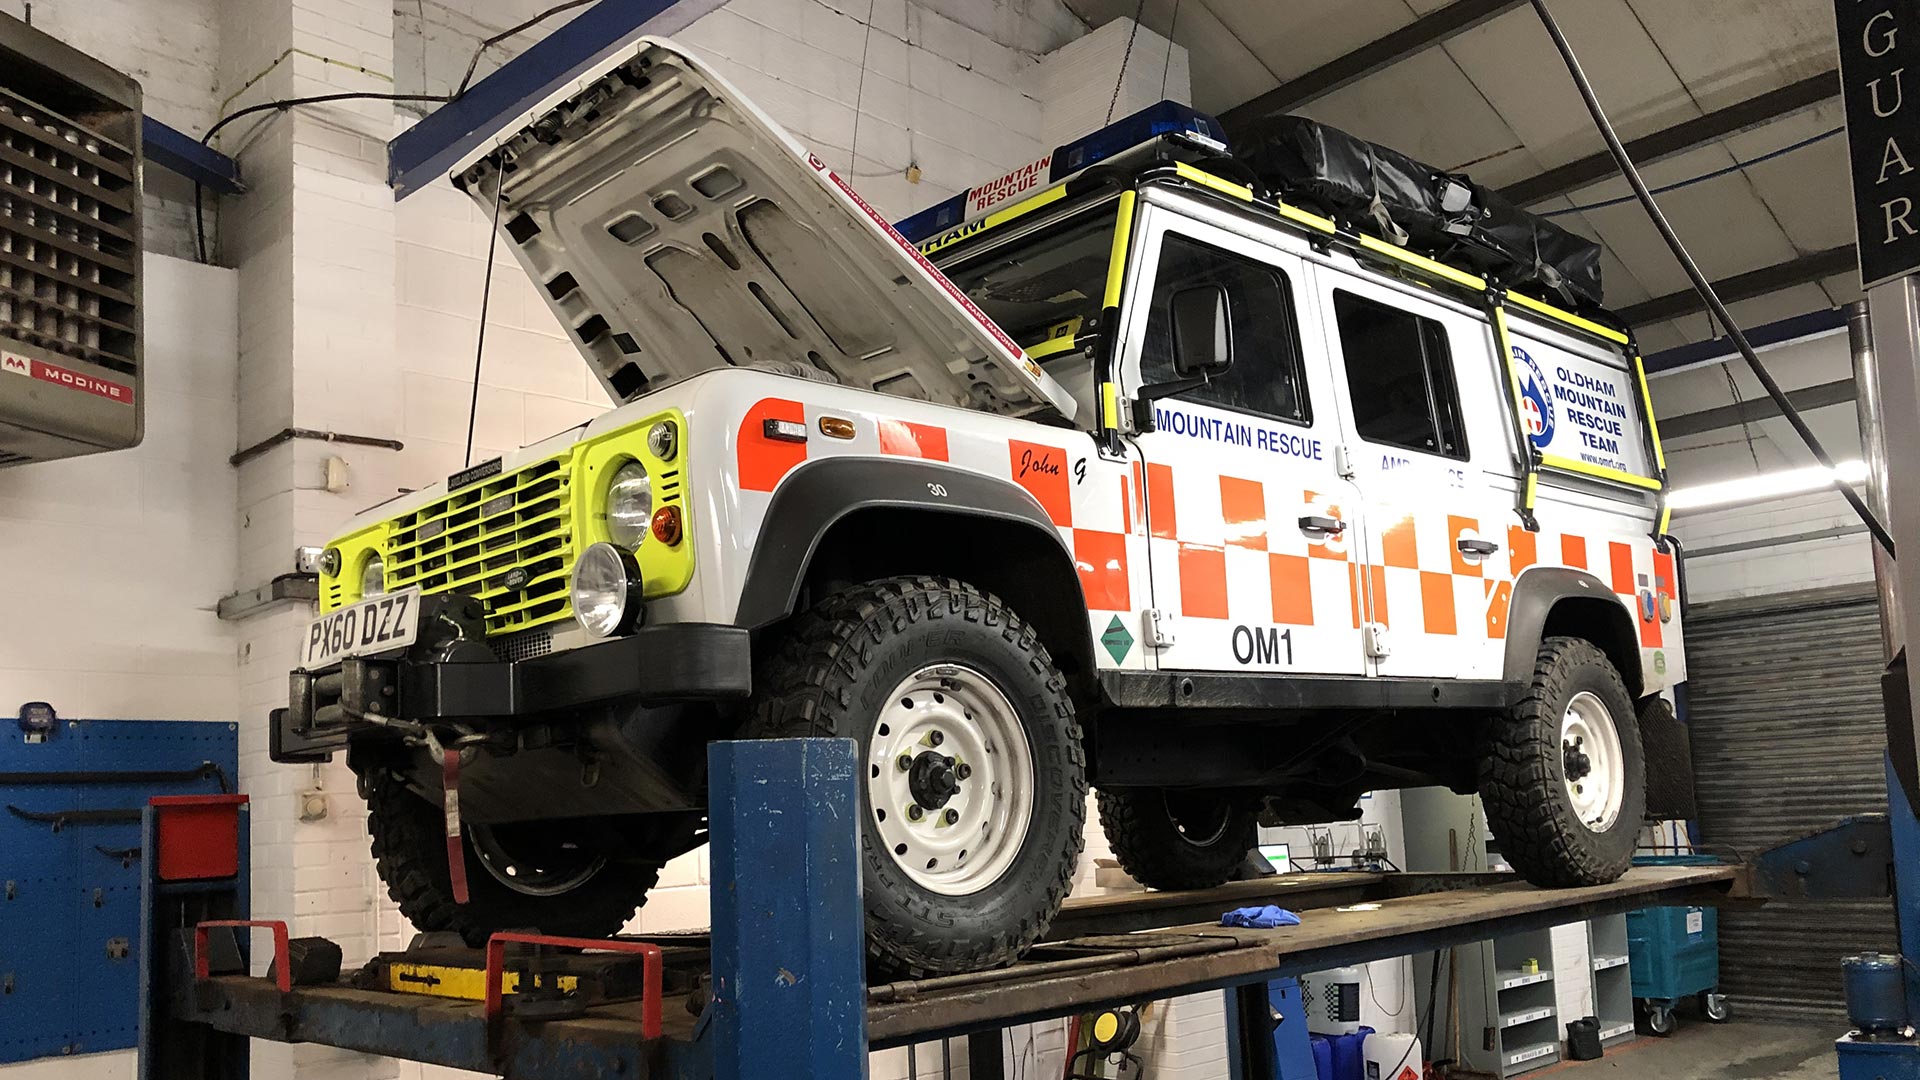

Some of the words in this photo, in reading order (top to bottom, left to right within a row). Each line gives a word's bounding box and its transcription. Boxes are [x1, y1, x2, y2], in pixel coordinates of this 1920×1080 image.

[1856, 0, 1919, 244] GUAR
[969, 156, 1051, 202] MOUNTAIN
[976, 173, 1039, 211] RESCUE
[918, 217, 987, 254] HAM
[838, 180, 873, 214] DONATED
[887, 227, 903, 242] THE
[903, 242, 922, 261] EAST
[922, 261, 966, 304] LANCASHIRE
[965, 302, 987, 324] MARK
[986, 322, 1016, 351] MASONS
[44, 368, 121, 397] MODINE
[1556, 366, 1616, 398] OLDHAM
[1553, 384, 1627, 419] MOUNTAIN
[1156, 408, 1252, 447] MOUNTAIN
[1566, 407, 1623, 437] RESCUE
[1257, 428, 1323, 461] RESCUE
[1579, 431, 1619, 455] TEAM
[1019, 449, 1060, 478] John
[927, 482, 948, 497] 30
[308, 609, 357, 662] PX60
[360, 594, 409, 646] DZZ
[1232, 624, 1293, 665] OM1
